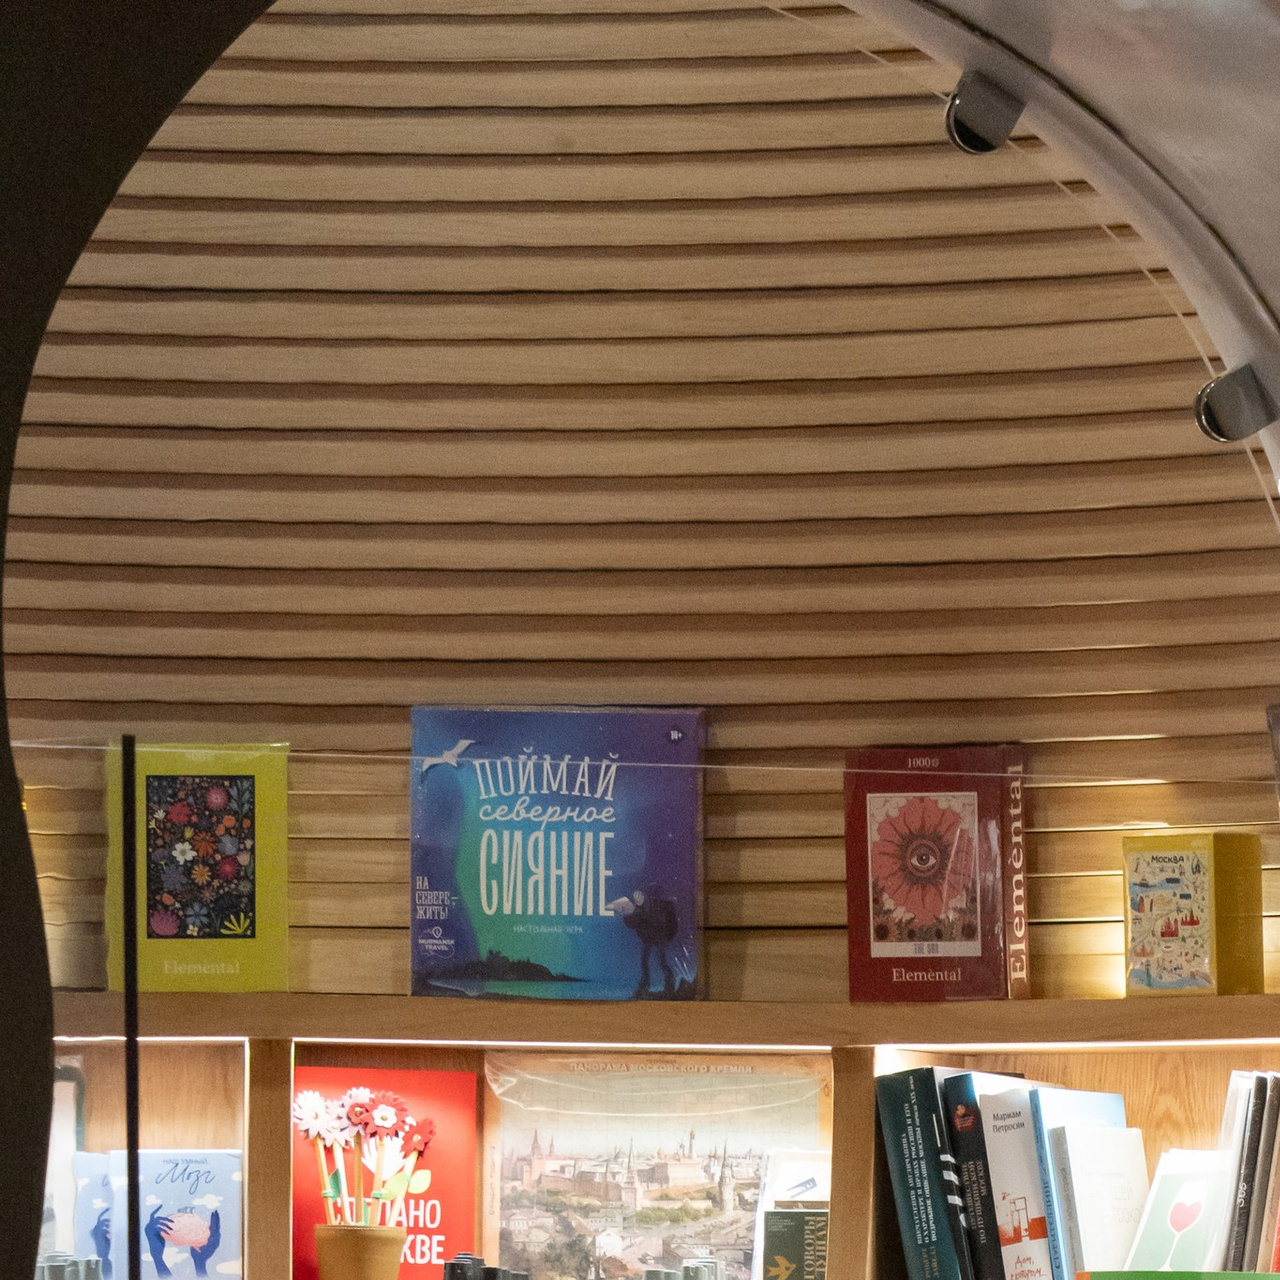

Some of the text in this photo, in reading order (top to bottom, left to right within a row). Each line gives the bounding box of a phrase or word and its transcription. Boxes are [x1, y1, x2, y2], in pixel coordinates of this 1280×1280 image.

[473, 747, 620, 800] ПОЙМАЙ
[479, 797, 616, 832] северное
[1151, 855, 1184, 864] МОСКВА
[480, 829, 616, 916] СИЯНИЕ
[416, 876, 430, 890] НА
[416, 906, 450, 920] ЖИТЬ!
[418, 938, 455, 946] MURMANSK
[425, 944, 450, 952] TRAVEL
[570, 1063, 754, 1074] ПАНОРАМА МОСКОВСКОГО КРЕМЛЯ
[993, 1110, 1022, 1122] Мариам
[992, 1122, 1026, 1134] Петросян
